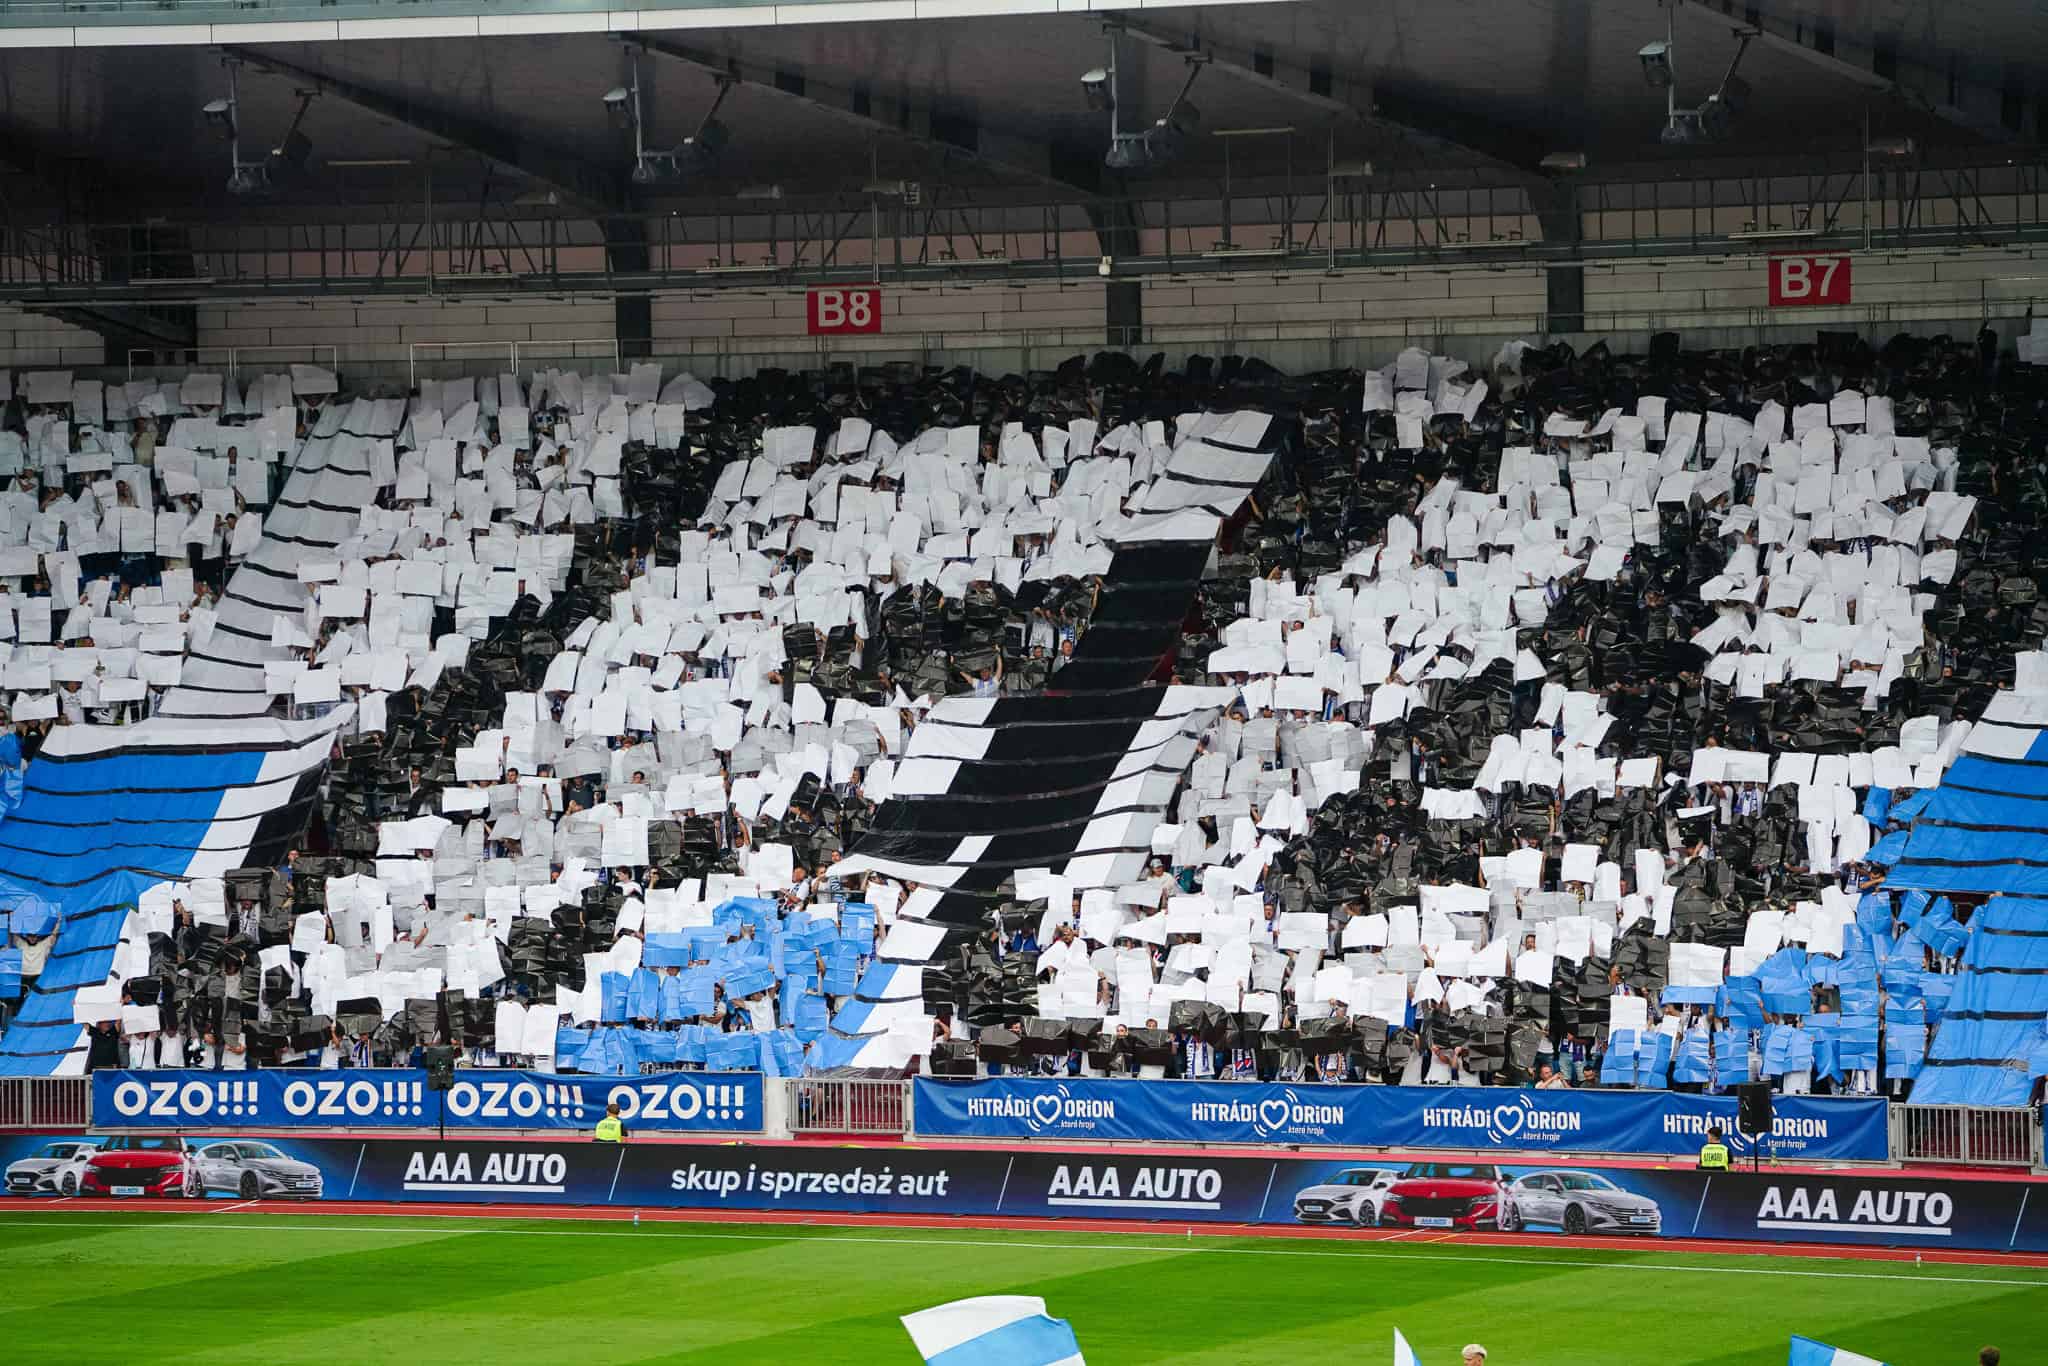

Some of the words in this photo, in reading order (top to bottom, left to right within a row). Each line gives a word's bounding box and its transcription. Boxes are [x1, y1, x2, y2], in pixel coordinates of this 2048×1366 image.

[1781, 258, 1840, 298] B7
[817, 290, 872, 328] B8
[112, 1080, 259, 1117] OZO!!!
[282, 1080, 423, 1117] OZO!!!
[446, 1081, 584, 1119] OZO!!!
[607, 1084, 745, 1121] OZO!!!
[404, 1151, 473, 1183] AAA
[480, 1153, 567, 1184] AUTO
[671, 1163, 741, 1198] skup
[746, 1163, 756, 1191] i
[759, 1166, 893, 1199] sprzedaż
[898, 1169, 950, 1197] aut
[1047, 1165, 1121, 1198] AAA
[1127, 1167, 1222, 1202] AUTO
[1757, 1186, 1840, 1222] AAA
[1847, 1190, 1954, 1227] AUTO
